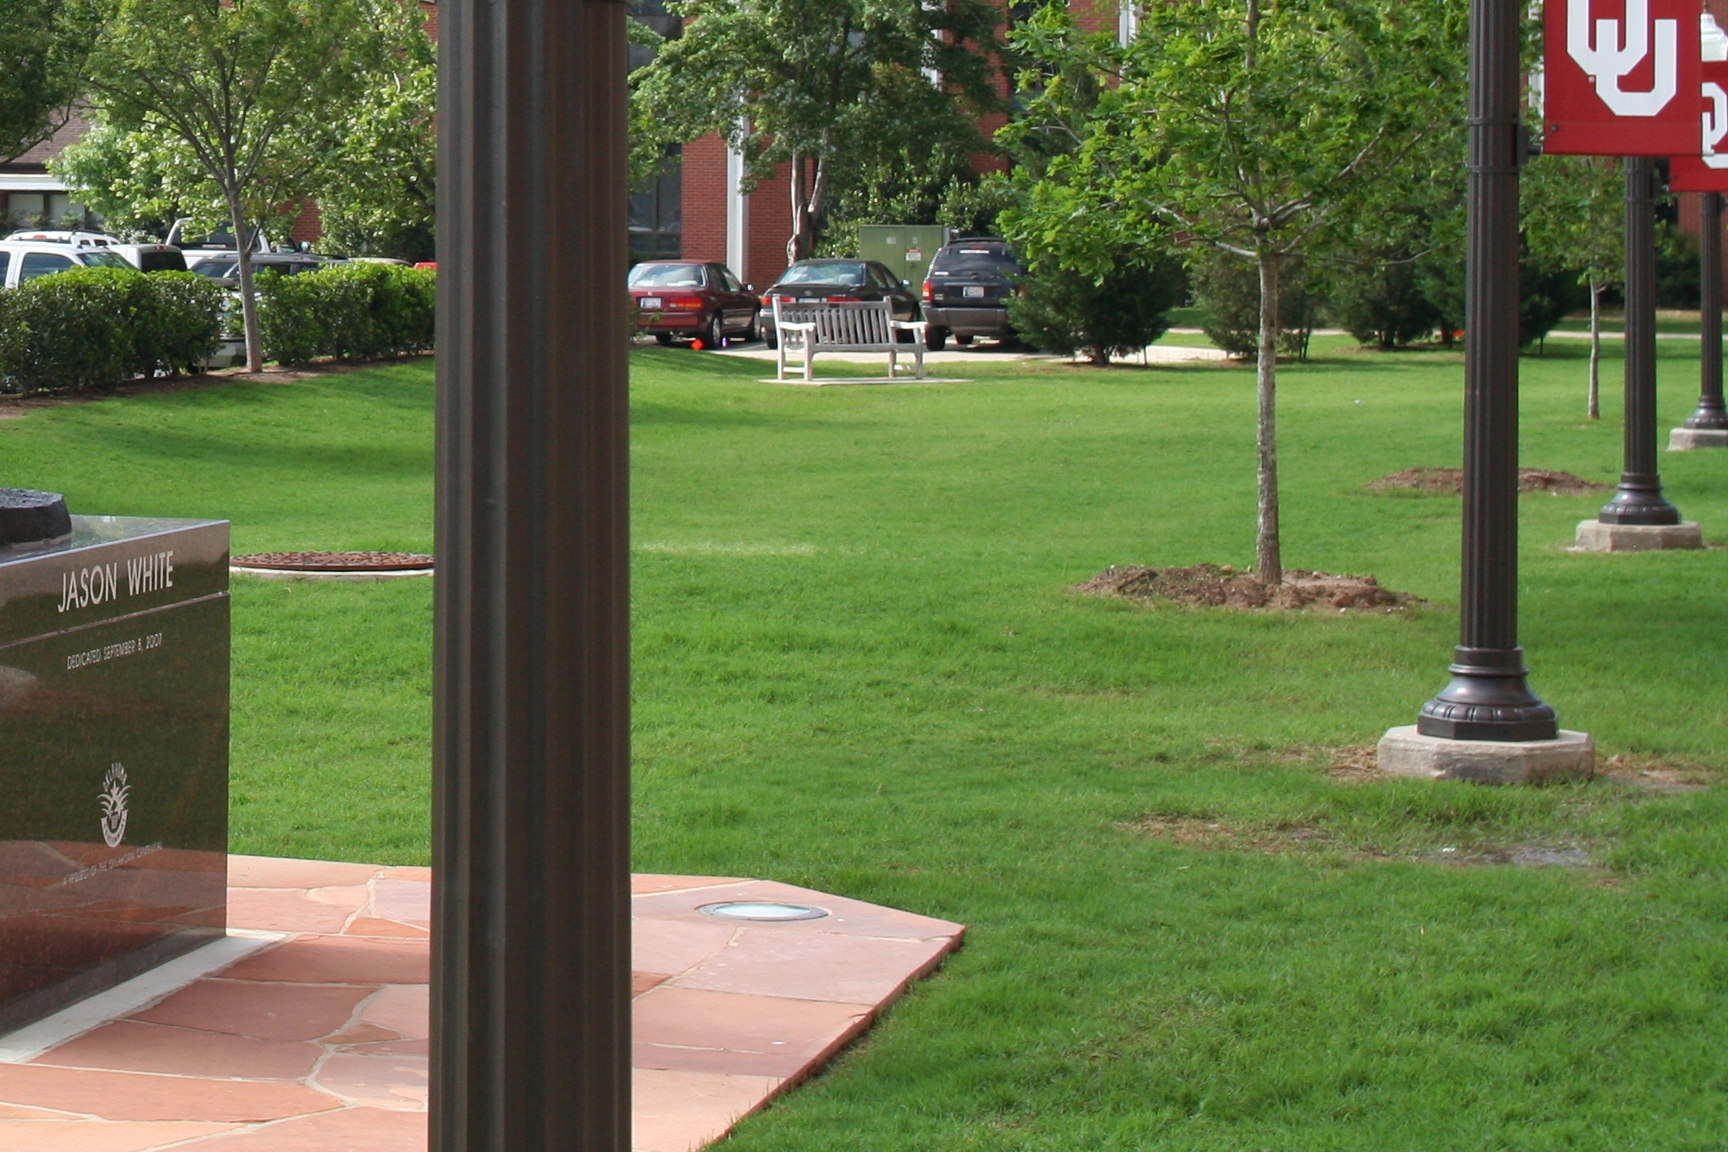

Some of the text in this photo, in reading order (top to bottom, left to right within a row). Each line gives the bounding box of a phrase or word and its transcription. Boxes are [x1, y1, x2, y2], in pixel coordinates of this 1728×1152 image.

[58, 550, 174, 613] JASON WHITE
[67, 648, 101, 670] DEDICATED
[103, 639, 136, 661] SEPTEMBER
